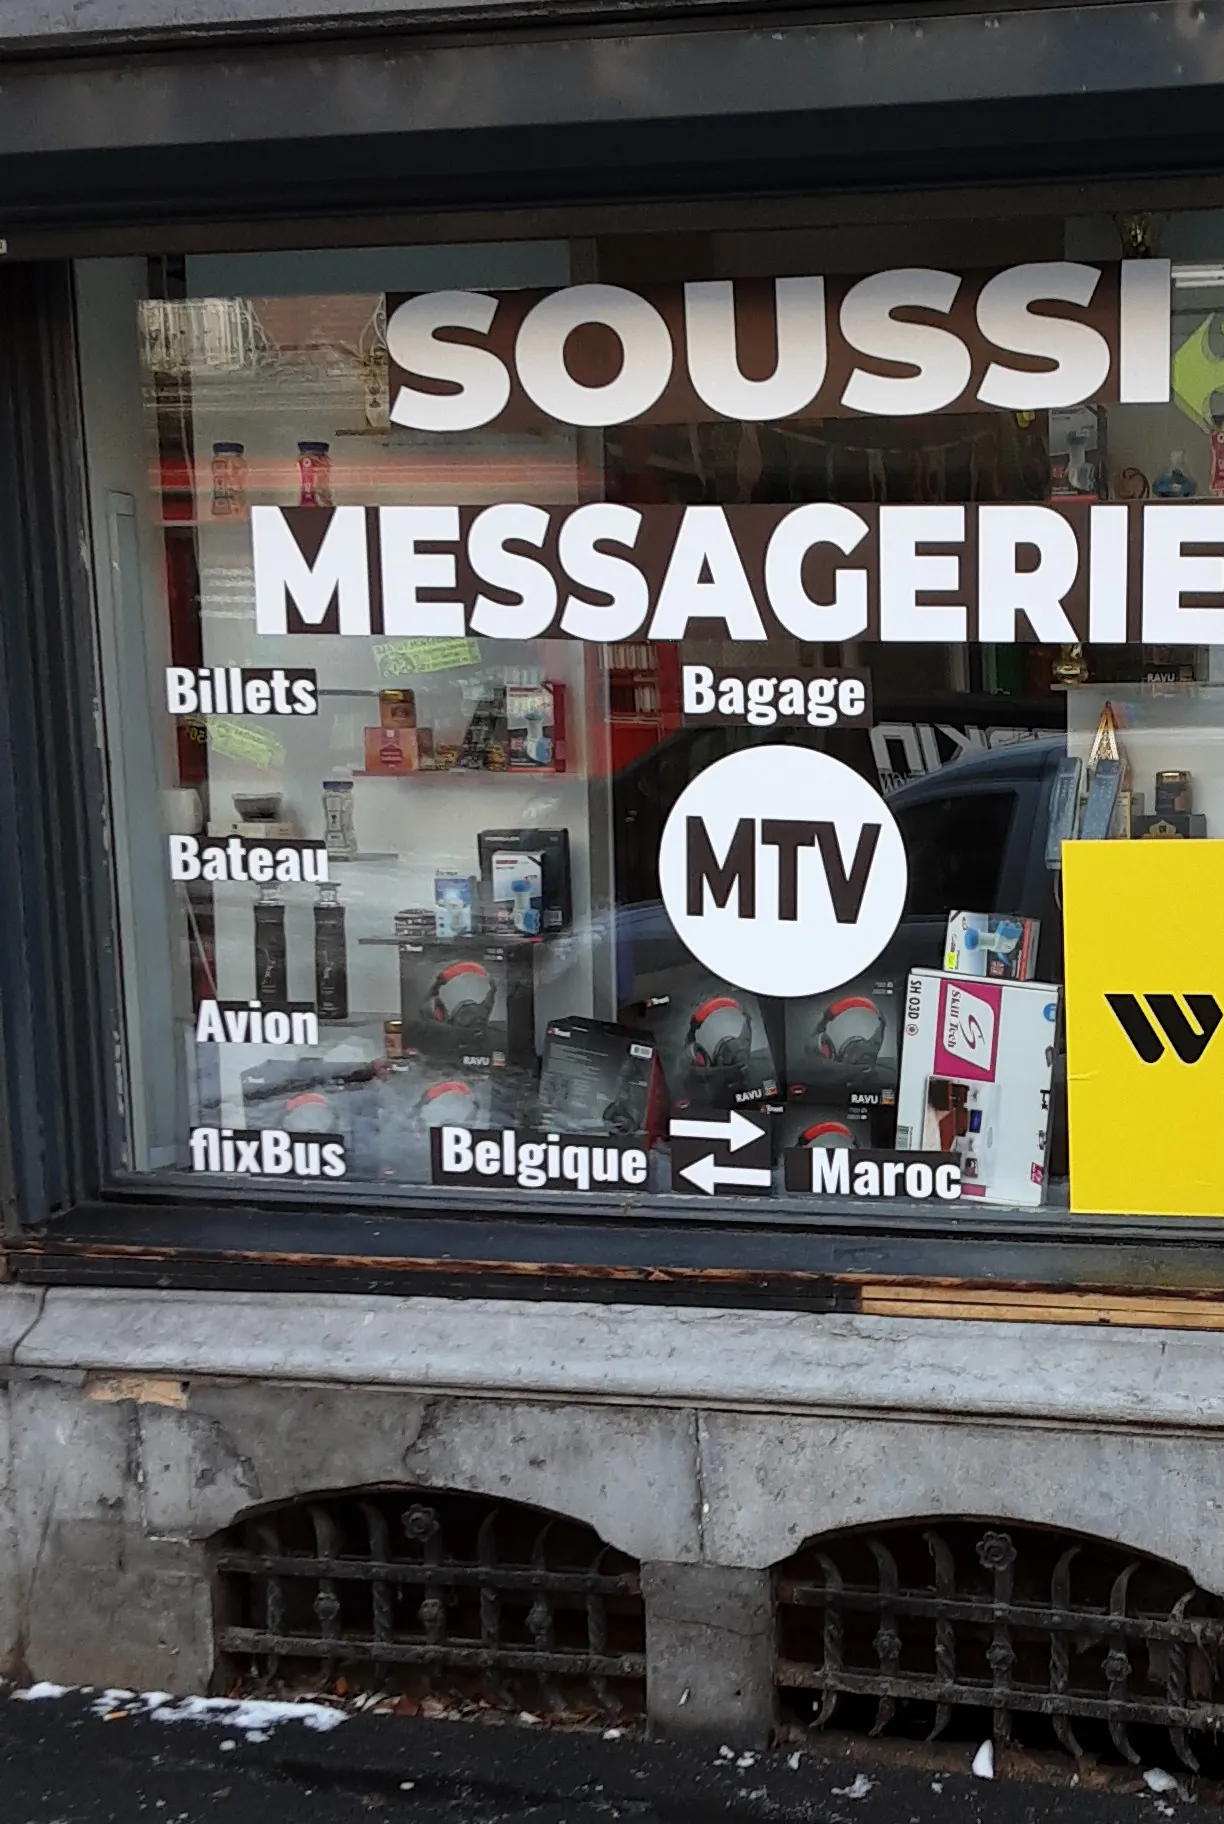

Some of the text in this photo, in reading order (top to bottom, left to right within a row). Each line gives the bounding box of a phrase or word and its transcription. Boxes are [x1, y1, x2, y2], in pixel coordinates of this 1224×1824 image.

[386, 258, 1171, 433] SOUSSI
[165, 667, 318, 714] Billets
[683, 665, 866, 727] Bagage
[1147, 672, 1175, 682] RAVU
[168, 836, 328, 884] Bateau
[685, 815, 883, 924] MTV
[909, 979, 923, 997] SH
[949, 988, 961, 1018] Skill
[196, 1000, 319, 1045] Avion
[463, 1055, 490, 1066] RAVU
[735, 1089, 763, 1103] RAVU
[851, 1094, 879, 1105] RAVU
[190, 1128, 346, 1177] flixBus
[441, 1127, 647, 1189] Belgique
[812, 1147, 962, 1200] Maroc
